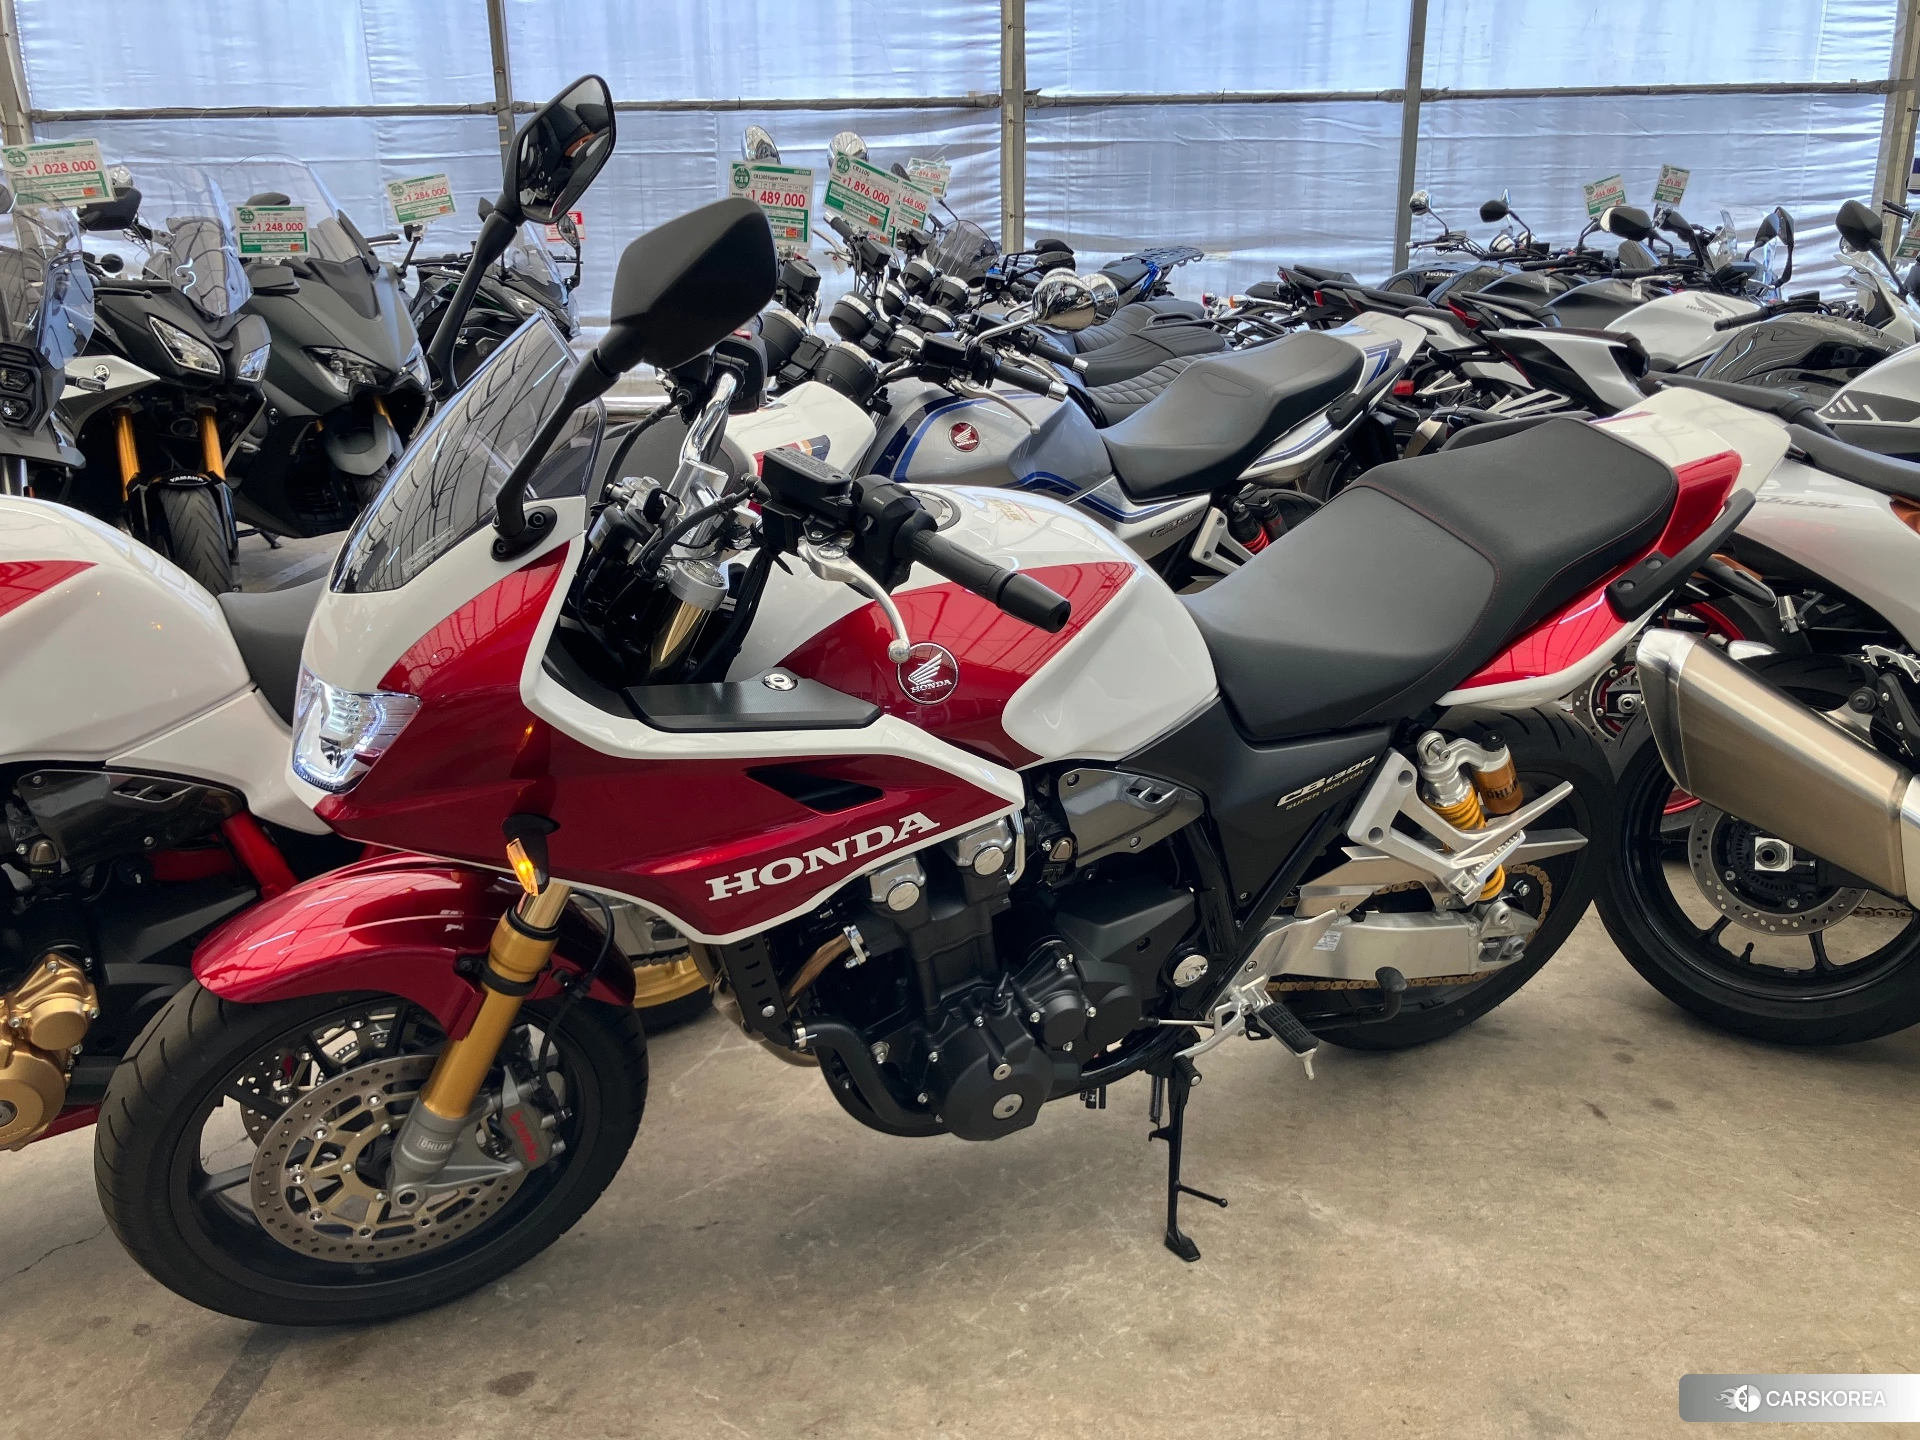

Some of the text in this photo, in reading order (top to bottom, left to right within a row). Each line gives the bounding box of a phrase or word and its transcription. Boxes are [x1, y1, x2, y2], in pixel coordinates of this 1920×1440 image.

[26, 160, 97, 176] ¥1,028,000
[745, 189, 806, 208] ¥1,489,000
[843, 177, 890, 205] ¥1,896,000
[252, 222, 304, 232] ¥1,248,000
[910, 679, 953, 694] HONDA
[1276, 755, 1376, 807] CB1300
[1285, 791, 1320, 811] SUPER
[704, 811, 941, 902] HONDA
